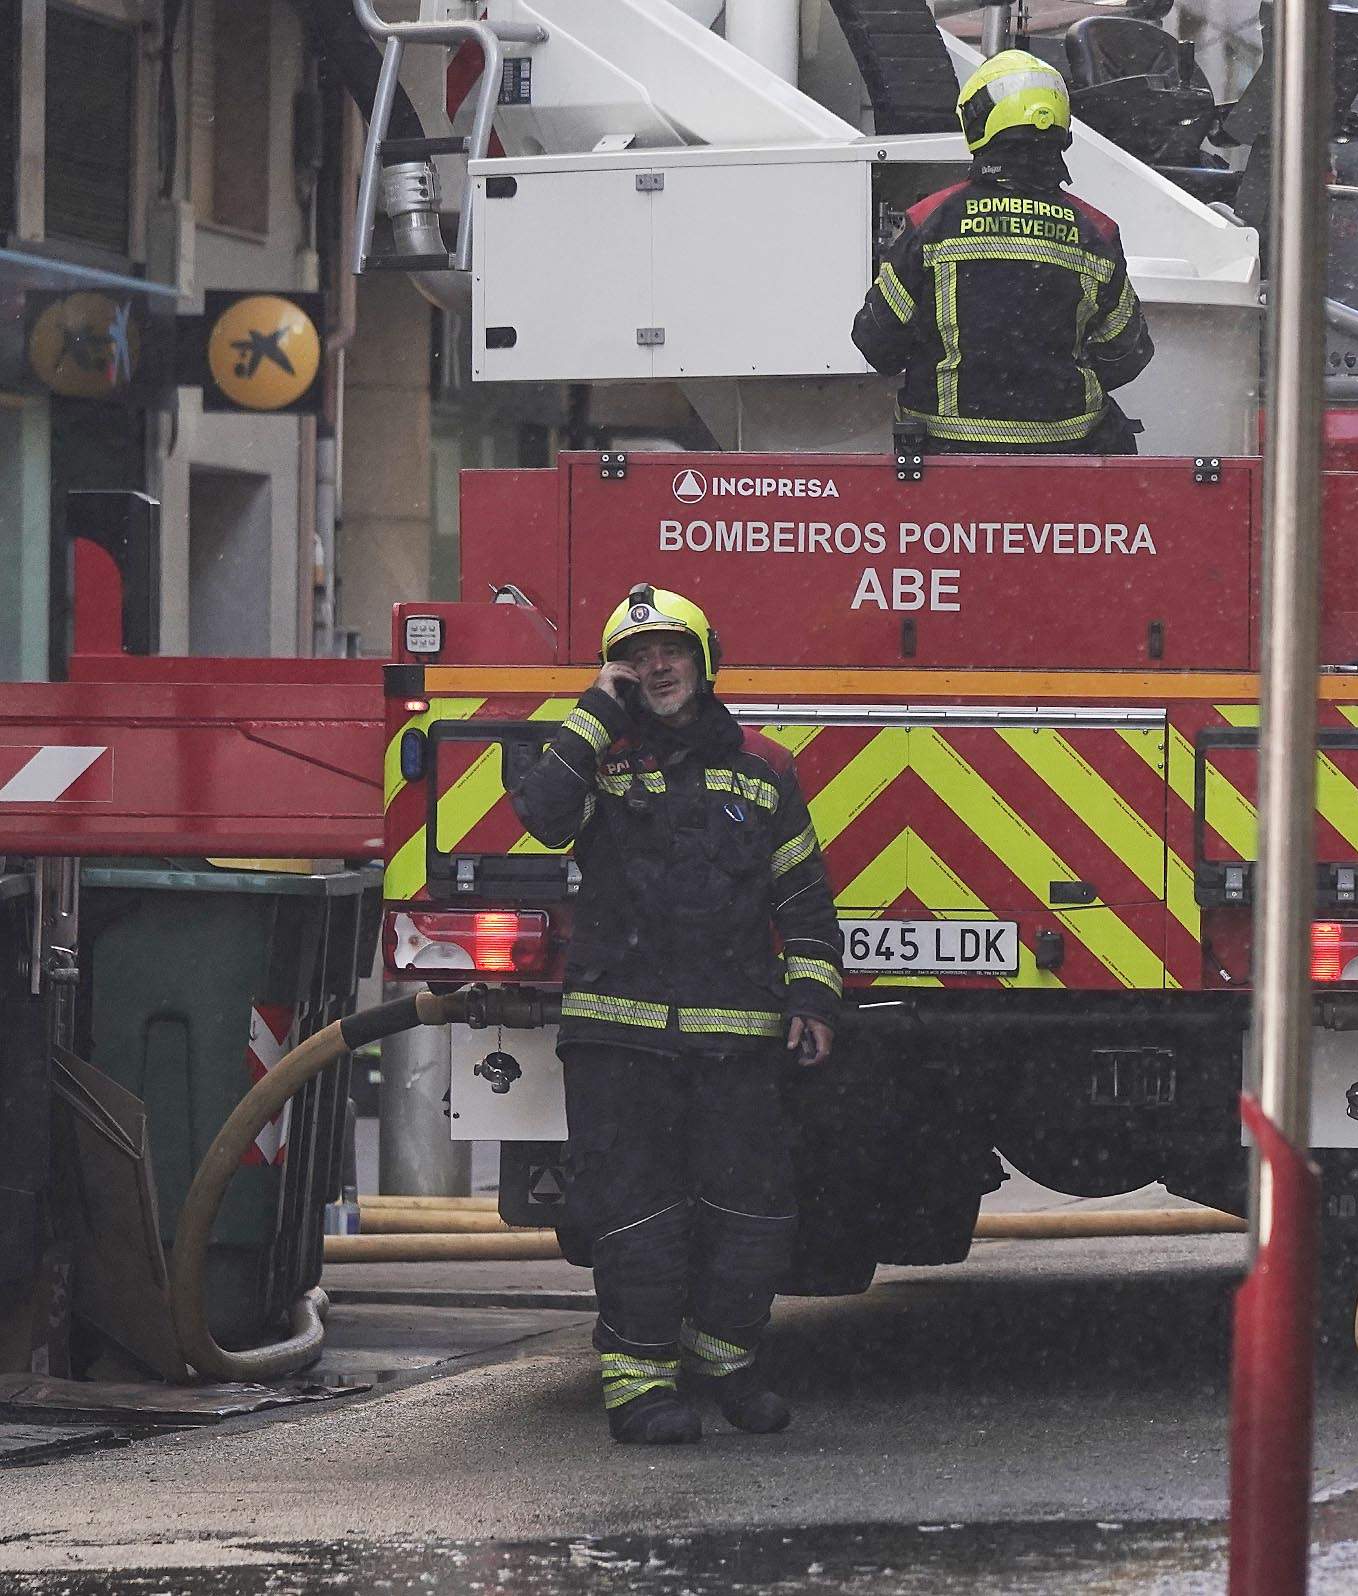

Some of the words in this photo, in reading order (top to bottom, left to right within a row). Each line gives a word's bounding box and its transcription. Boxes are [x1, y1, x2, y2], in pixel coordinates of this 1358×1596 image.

[965, 197, 1075, 222] BOMBEIROS
[960, 216, 1079, 244] PONTEVEDRA
[712, 477, 840, 498] INCIPRESA
[659, 519, 887, 553] BOMBEIROS
[899, 522, 1157, 554] PONTEVEDRA
[850, 567, 961, 611] ABE
[839, 927, 919, 961] 645
[935, 928, 1006, 963] LDK
